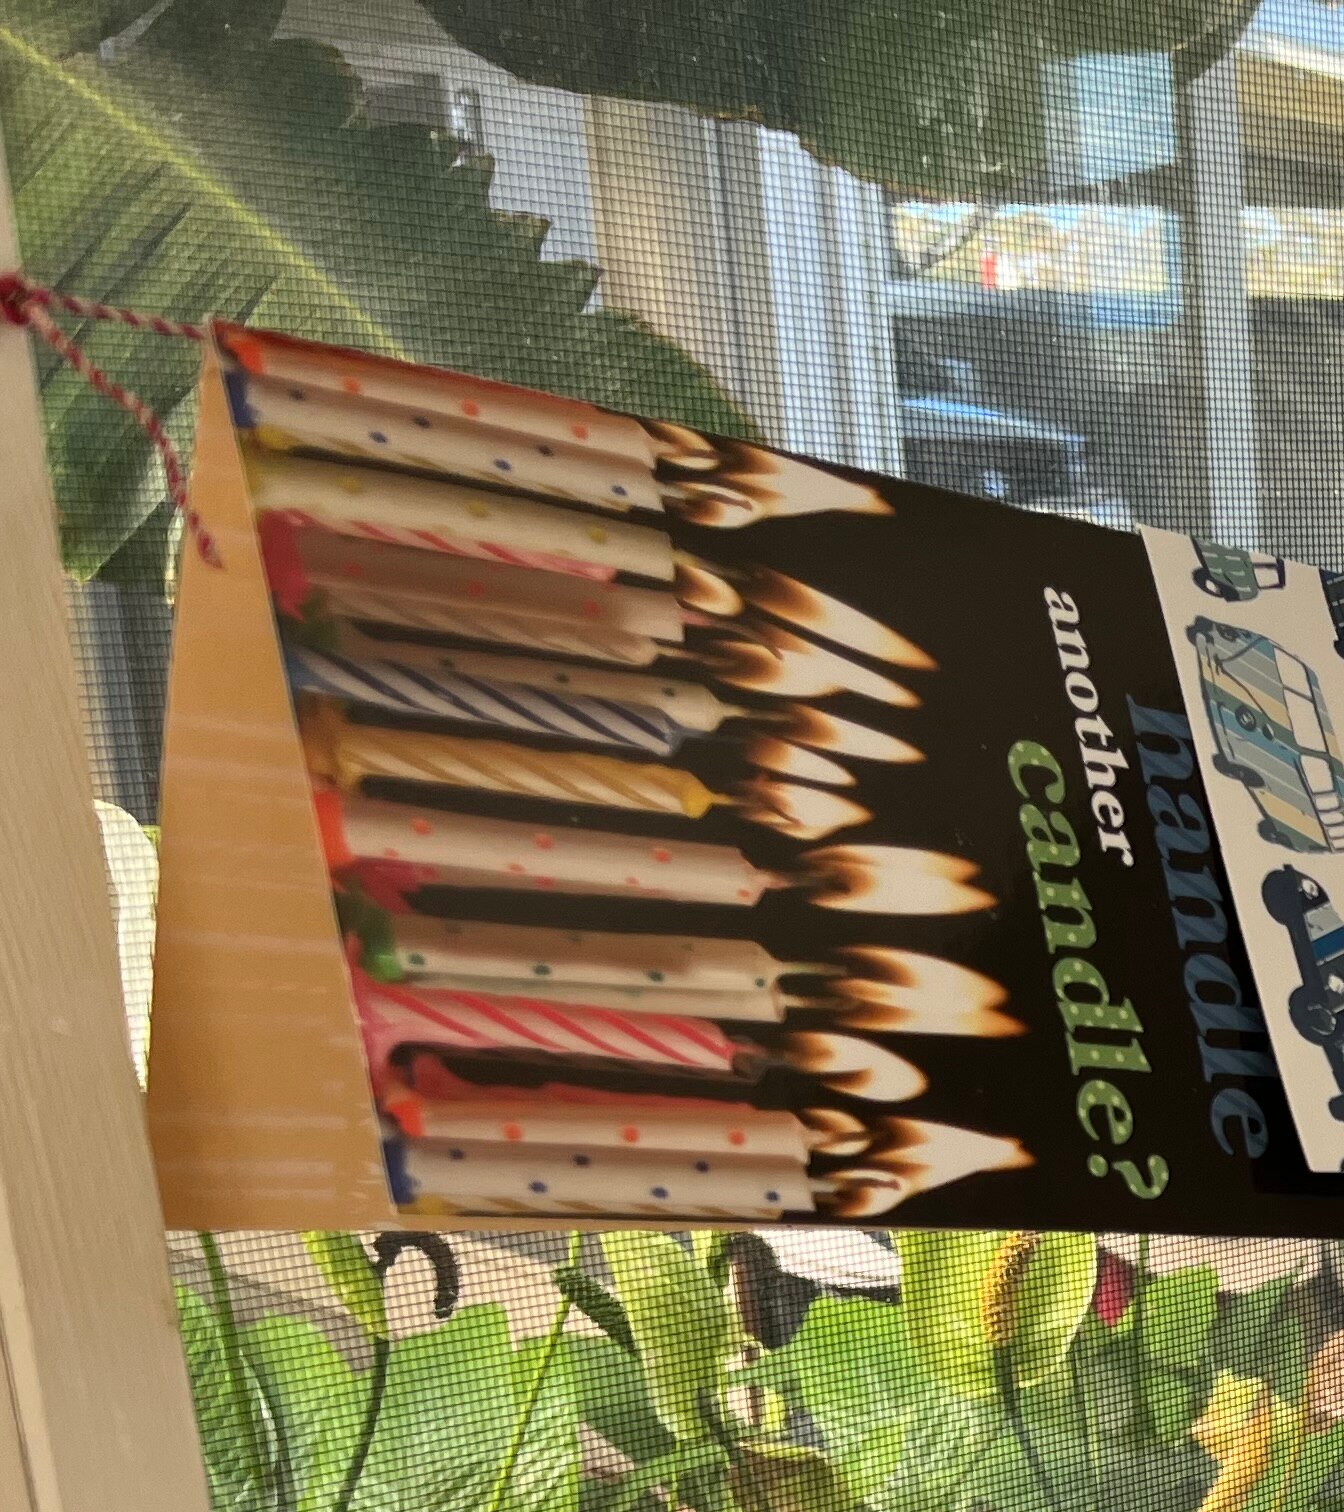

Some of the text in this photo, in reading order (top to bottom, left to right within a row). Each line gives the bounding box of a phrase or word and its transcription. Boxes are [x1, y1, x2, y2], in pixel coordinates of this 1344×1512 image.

[1044, 587, 1135, 867] another
[1127, 693, 1278, 1160] handle
[1007, 740, 1170, 1200] candle?
